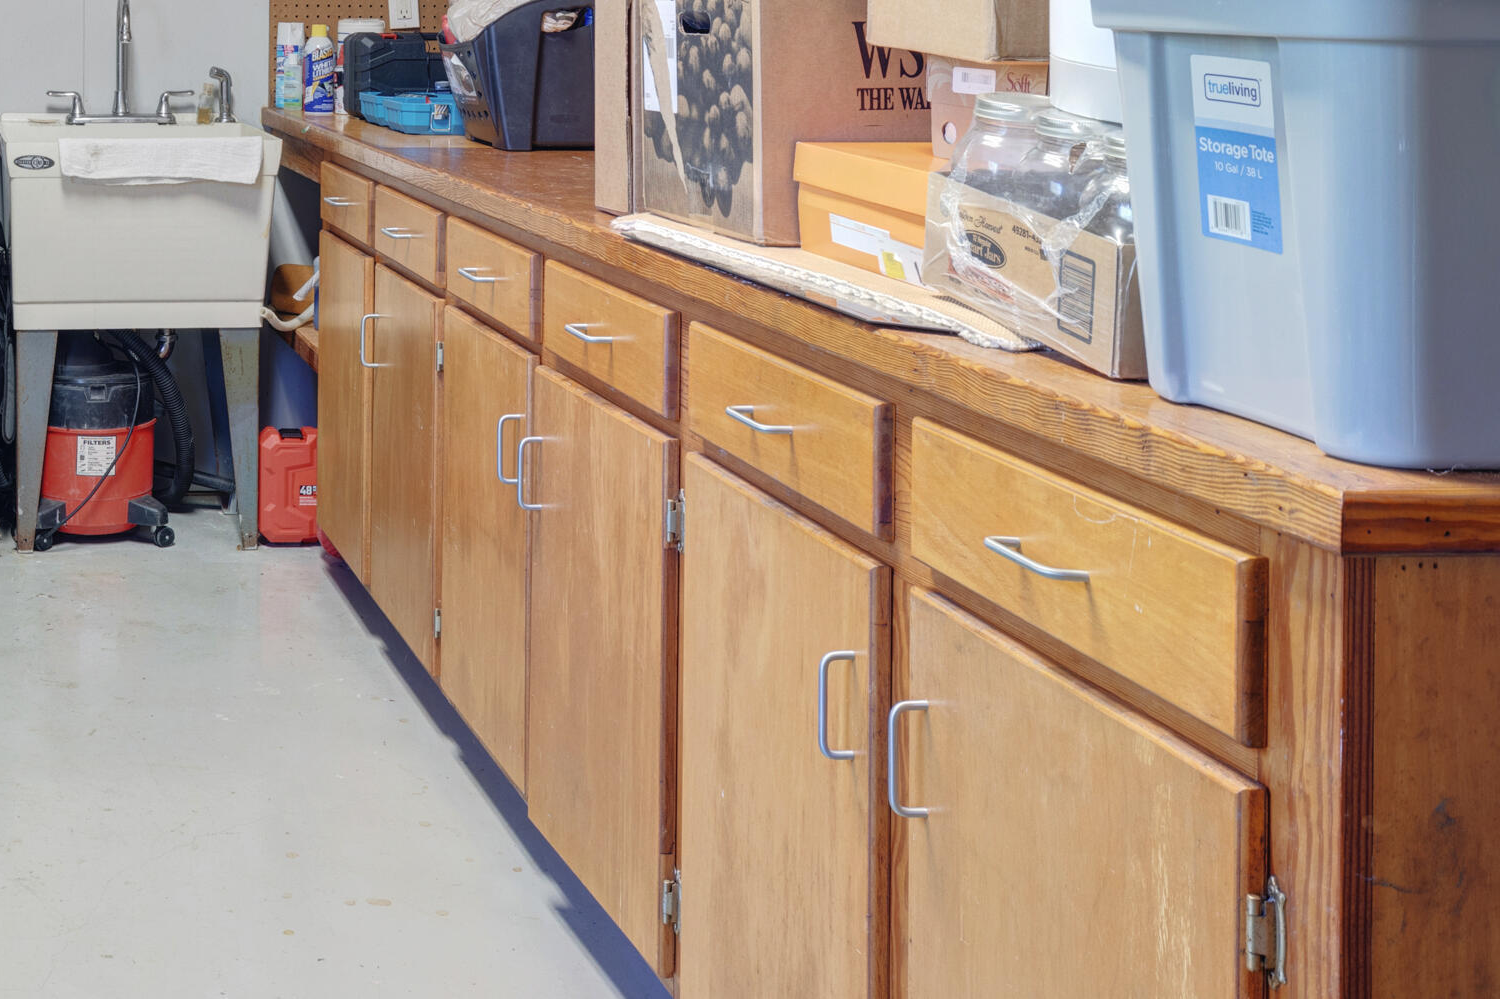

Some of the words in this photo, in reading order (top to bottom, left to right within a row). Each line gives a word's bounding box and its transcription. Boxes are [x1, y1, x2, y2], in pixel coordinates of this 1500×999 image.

[851, 21, 928, 79] WS
[857, 87, 894, 111] THE
[1207, 80, 1258, 101] trueliving
[1199, 137, 1248, 159] Storage
[1248, 144, 1275, 164] Tote
[1214, 161, 1224, 172] 10
[1225, 162, 1239, 174] Gal
[1245, 166, 1257, 178] 38
[1257, 168, 1263, 180] L
[300, 485, 313, 495] 48
